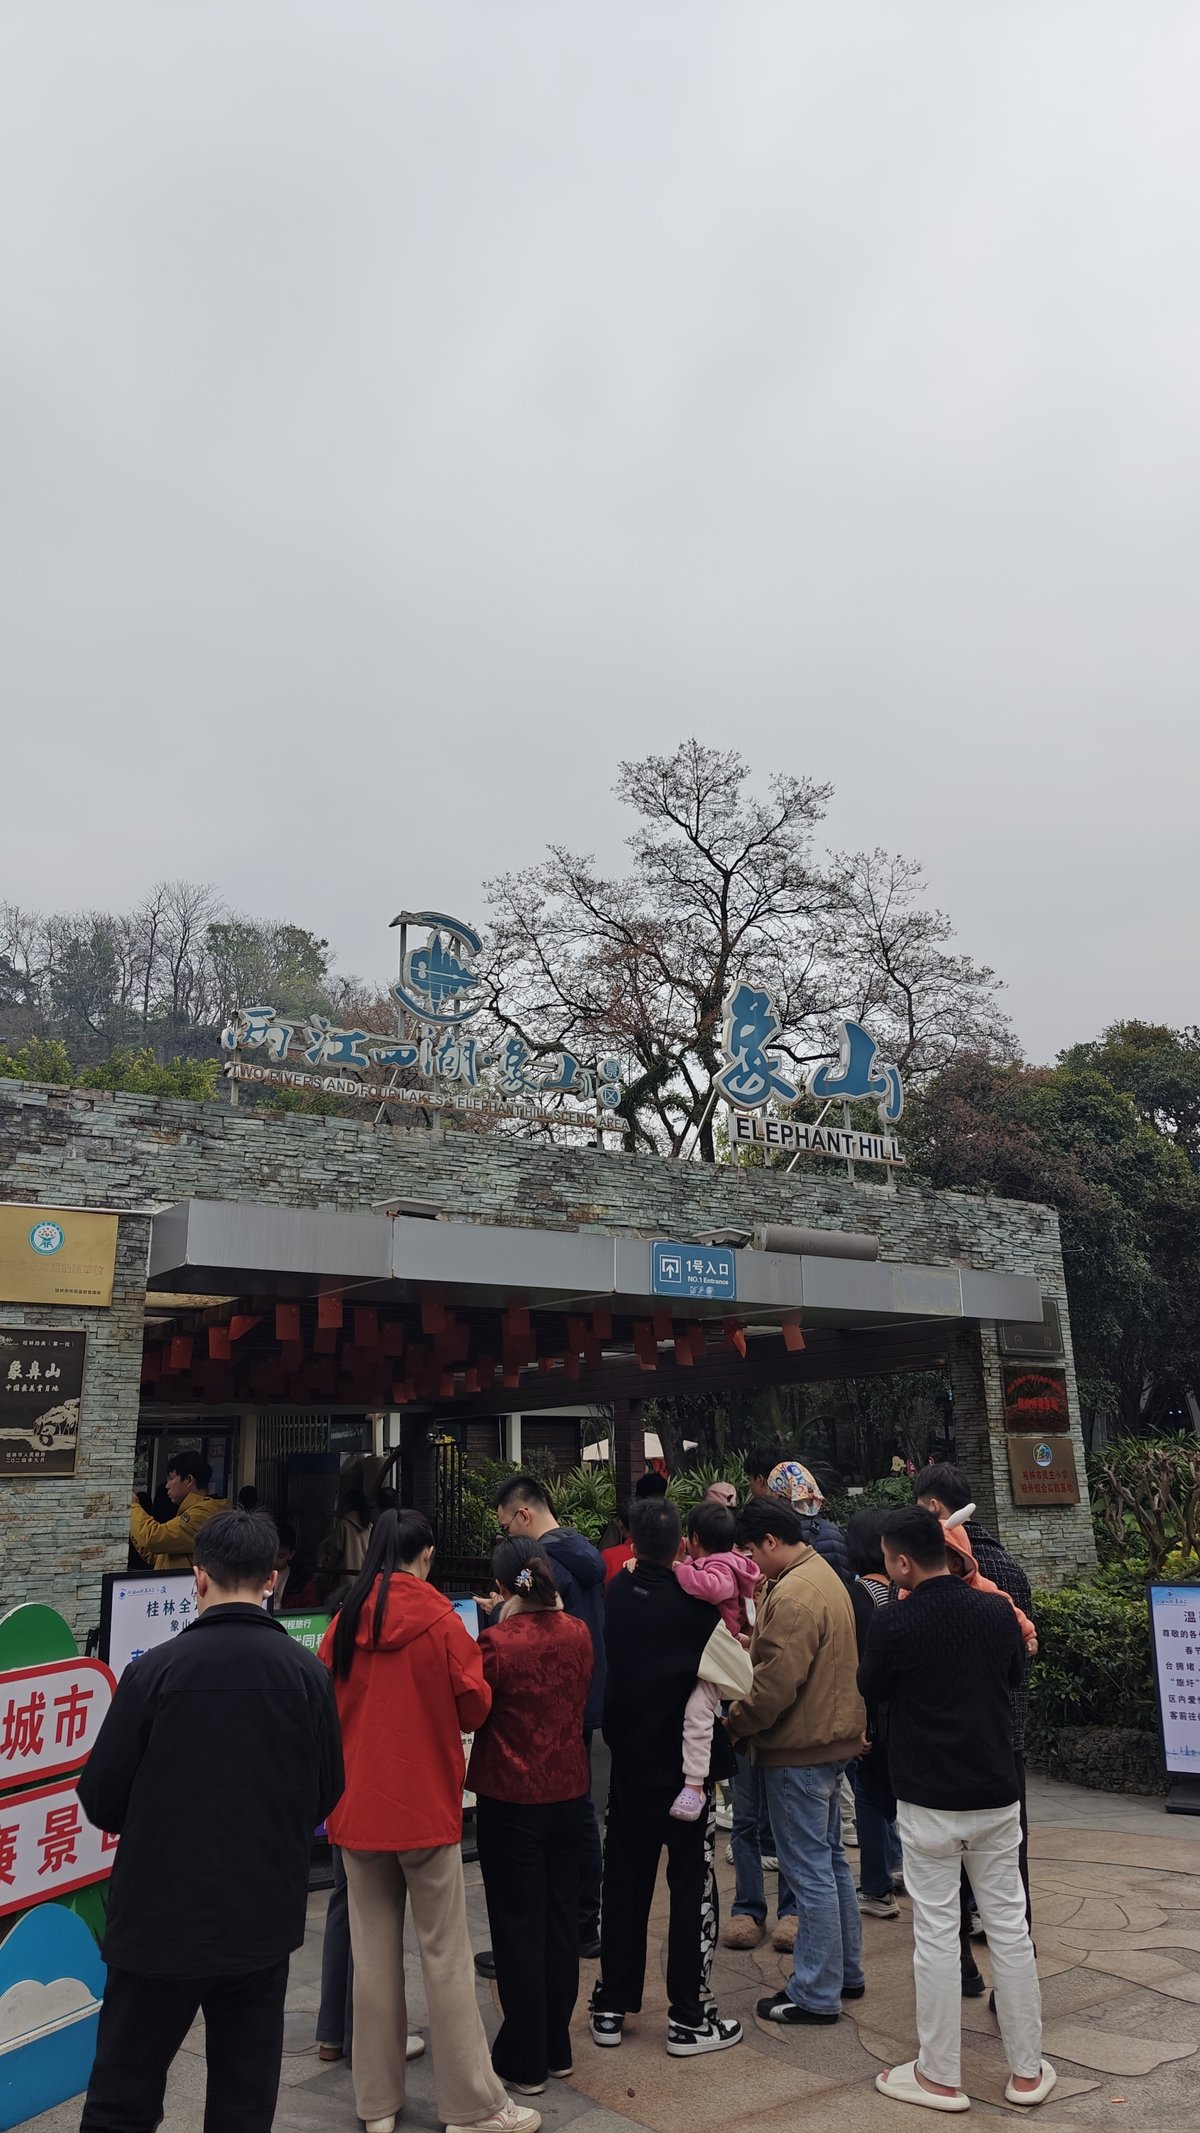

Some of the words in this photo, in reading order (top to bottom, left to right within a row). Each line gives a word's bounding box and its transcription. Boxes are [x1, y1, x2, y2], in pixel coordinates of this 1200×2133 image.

[713, 982, 903, 1120] 象山
[231, 1063, 264, 1080] TWO
[269, 1070, 323, 1089] RIVERS
[326, 1078, 357, 1094] AND
[360, 1084, 398, 1101] FOUR
[400, 1088, 443, 1106] LAKES
[456, 1097, 522, 1118] ELEPHANT
[553, 1111, 596, 1126] SCENIC
[599, 1116, 630, 1131] AREA
[736, 1117, 854, 1155] ELEPHANT
[859, 1136, 904, 1163] HILL
[686, 1259, 729, 1276] 1号入口
[687, 1275, 703, 1283] NO.1
[703, 1277, 729, 1286] Entrance
[7, 1360, 61, 1380] 象鼻山
[146, 1598, 198, 1618] 桂林全
[1183, 1611, 1200, 1623] 温
[1162, 1629, 1200, 1639] 尊敬的各
[0, 1683, 94, 1761] 城市
